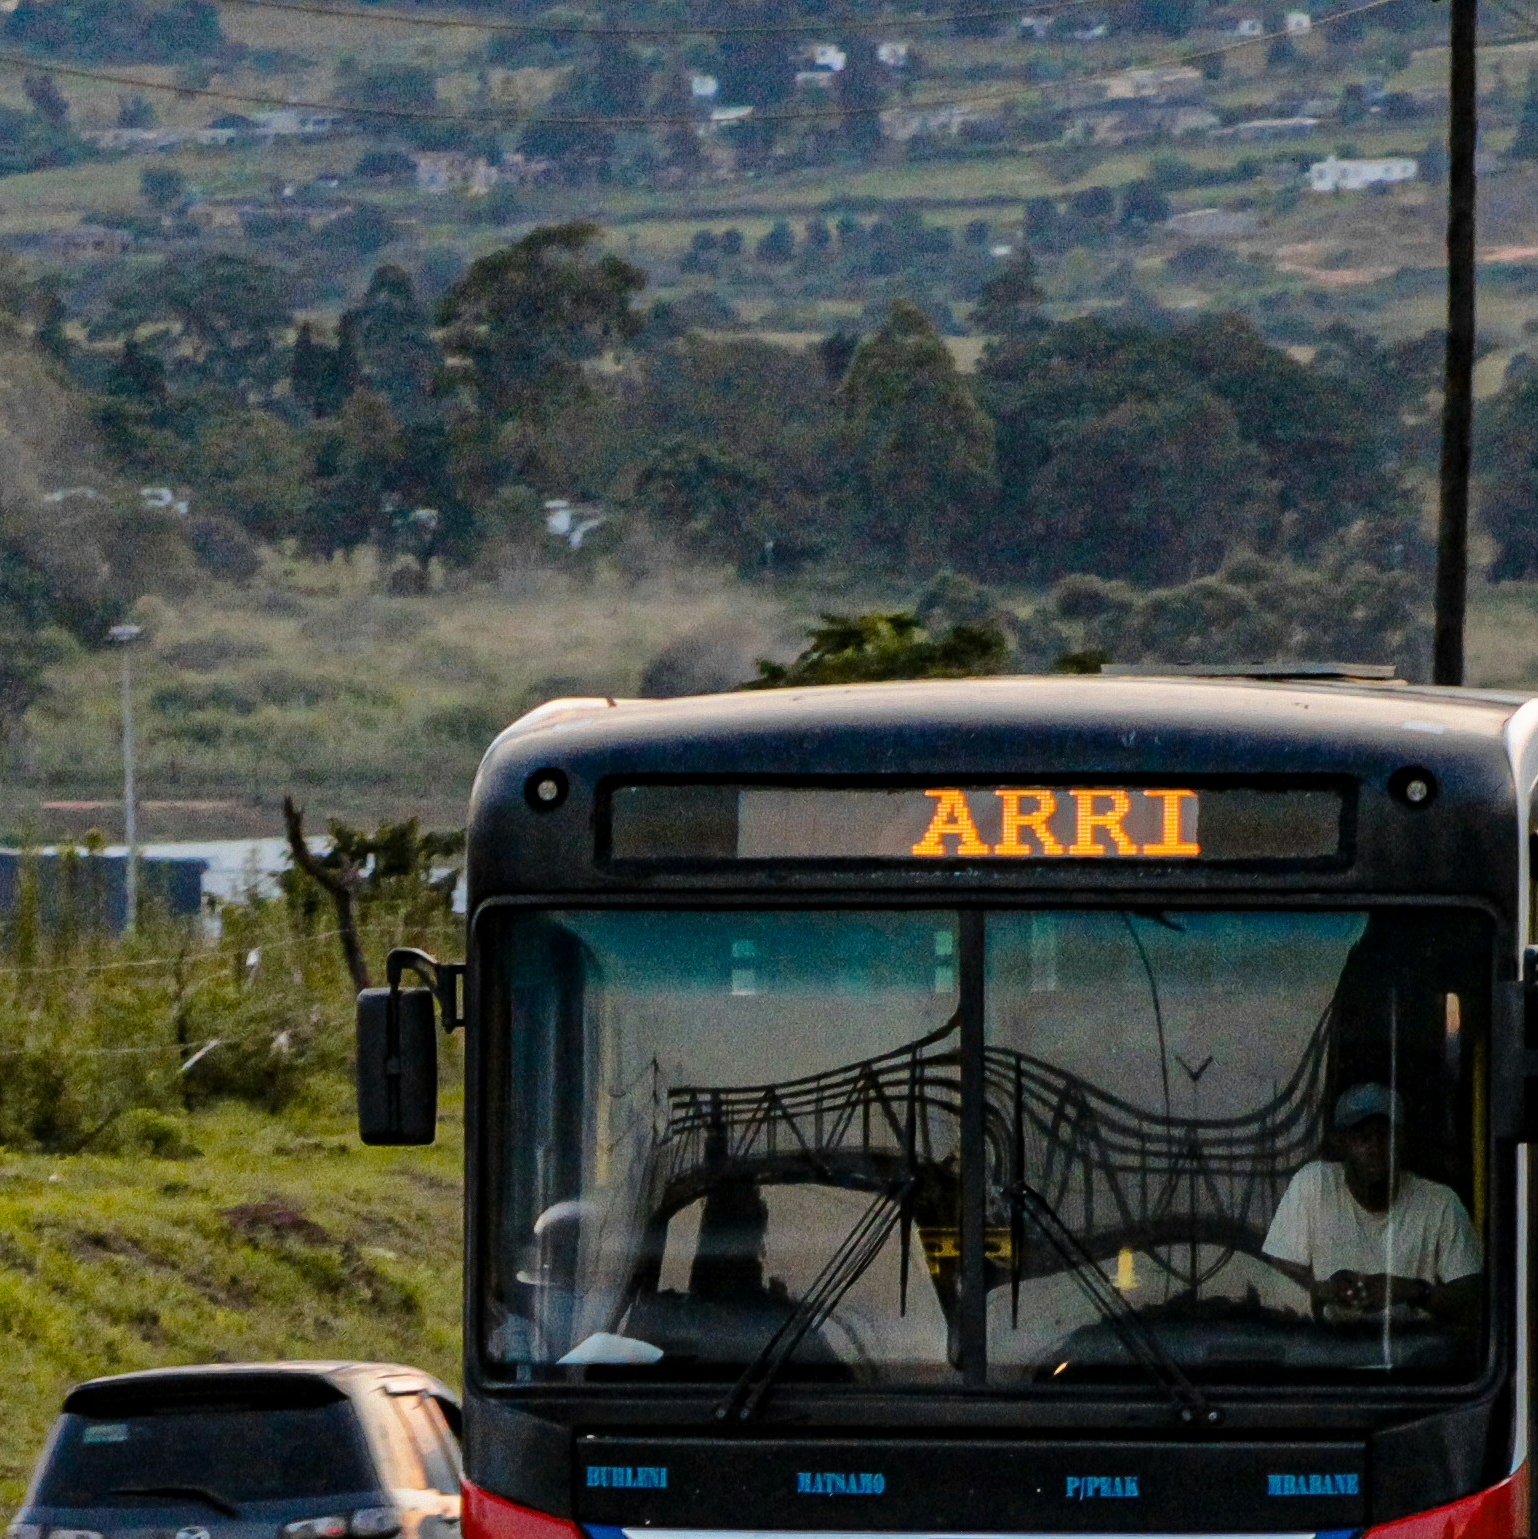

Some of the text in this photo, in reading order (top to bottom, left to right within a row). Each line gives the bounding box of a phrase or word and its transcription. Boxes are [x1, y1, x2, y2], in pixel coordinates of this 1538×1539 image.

[912, 789, 1200, 856] ARRI
[797, 1472, 886, 1494] MATSAMO
[1267, 1474, 1359, 1496] MBABANE
